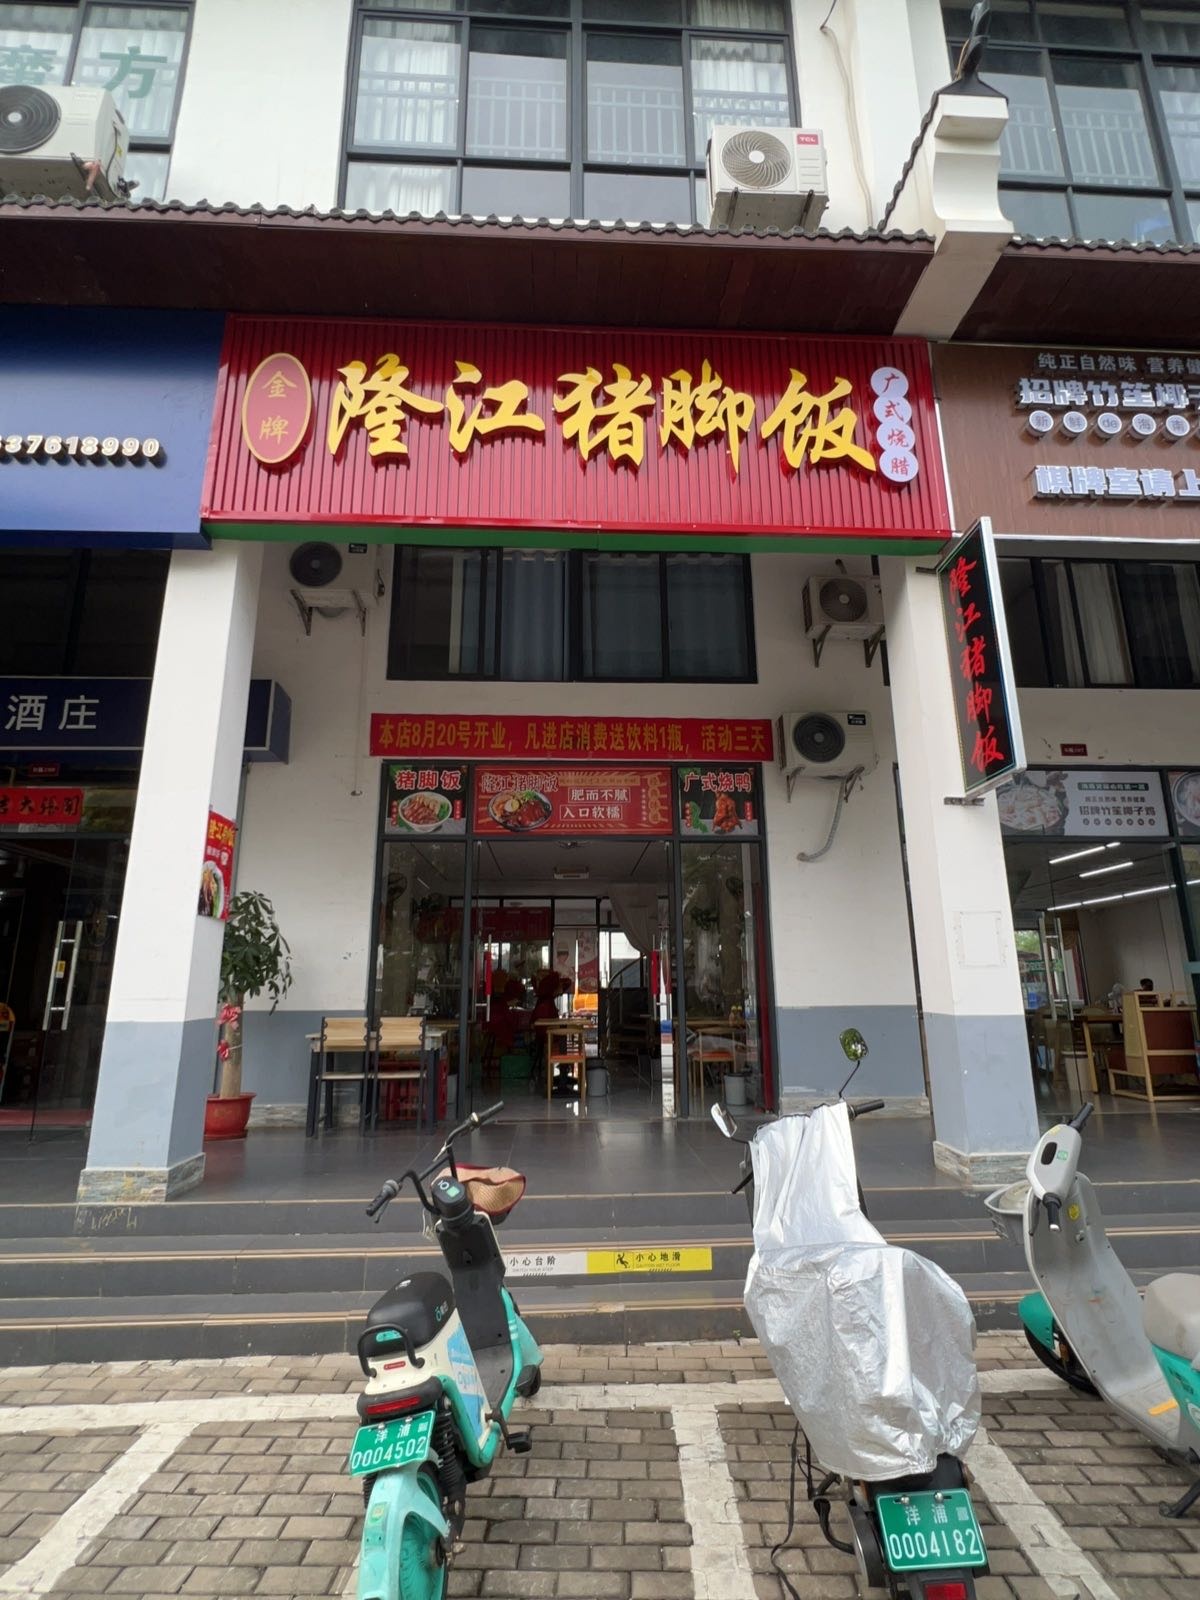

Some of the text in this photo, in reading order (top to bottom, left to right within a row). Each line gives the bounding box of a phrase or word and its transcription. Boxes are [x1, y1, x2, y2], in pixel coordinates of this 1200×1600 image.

[1038, 353, 1137, 371] 纯正自然味
[259, 370, 297, 445] 金牌
[328, 353, 876, 473] 隆江猪脚饭
[882, 372, 911, 476] 广式烧腊
[0, 435, 160, 457] 37618990
[949, 556, 1004, 773] 隆江猪脚饭
[5, 695, 99, 731] 酒庄
[395, 769, 461, 791] 猪脚饭
[684, 772, 751, 792] 广式烧鸭
[571, 788, 628, 801] 肥而不腻
[563, 805, 622, 819] 入口软糯
[509, 1255, 556, 1267] 小心台阶
[636, 1251, 681, 1262] 小心地滑
[352, 1435, 427, 1470] 0004502
[904, 1503, 949, 1526] 洋浦
[889, 1529, 980, 1560] 0004182
